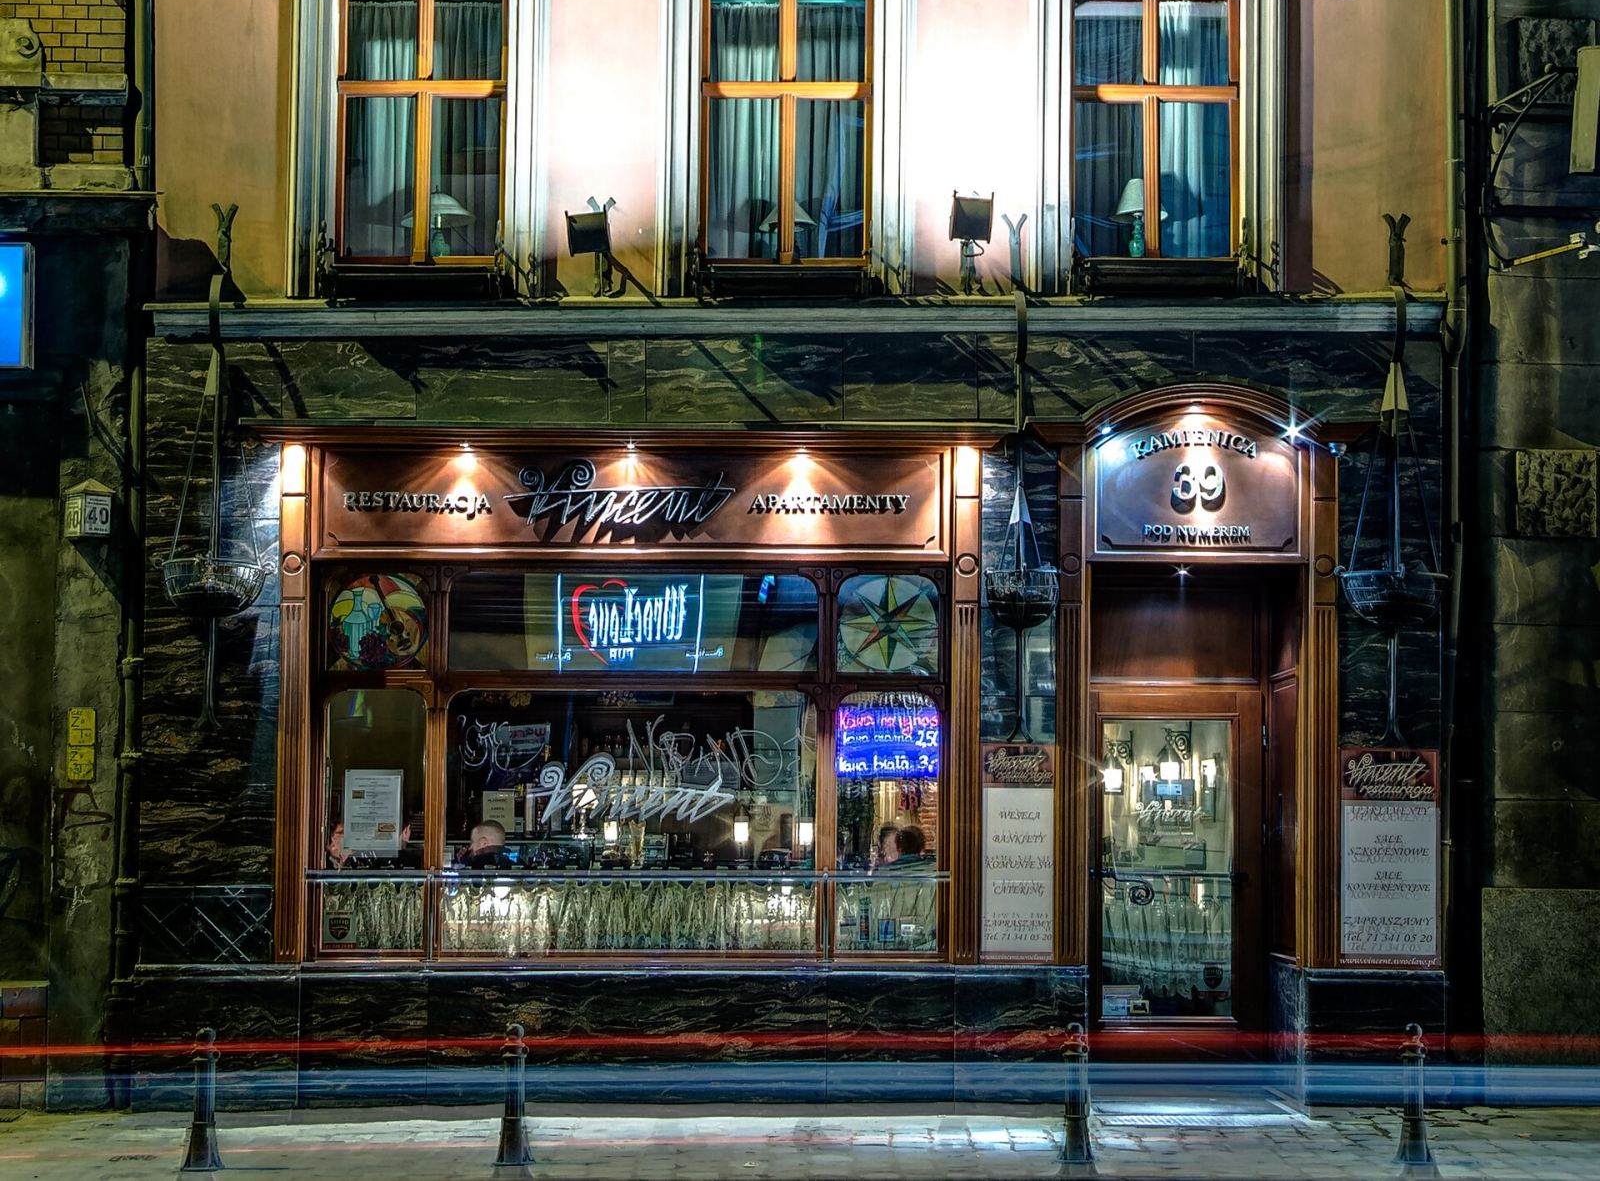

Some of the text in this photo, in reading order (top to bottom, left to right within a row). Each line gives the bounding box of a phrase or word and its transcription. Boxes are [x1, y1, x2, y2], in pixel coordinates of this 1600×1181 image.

[1130, 429, 1258, 459] KAMIENICA
[1172, 462, 1224, 501] 39
[503, 459, 736, 525] Vincent
[343, 491, 492, 511] RESTAURACJA
[752, 493, 911, 511] APARTAMENTY
[87, 507, 109, 525] 40
[1144, 524, 1251, 538] POD NUMEREM
[1360, 783, 1436, 798] restauracja
[999, 811, 1041, 820] WESELA
[992, 833, 1047, 845] BANKIETY
[1373, 834, 1404, 844] SALE
[1347, 847, 1430, 857] SZKOLENIOWE
[1373, 870, 1403, 881] SALE
[994, 884, 1045, 897] CATERING
[1345, 882, 1431, 893] KONFERENCYJNE
[984, 919, 1053, 929] ZAPRASZAMY
[1343, 916, 1434, 927] ZAPRASZAMY
[1001, 933, 1012, 941] 71
[1366, 933, 1379, 942] 71
[1381, 933, 1400, 942] 341
[1404, 933, 1417, 943] 05
[1420, 934, 1433, 943] 20
